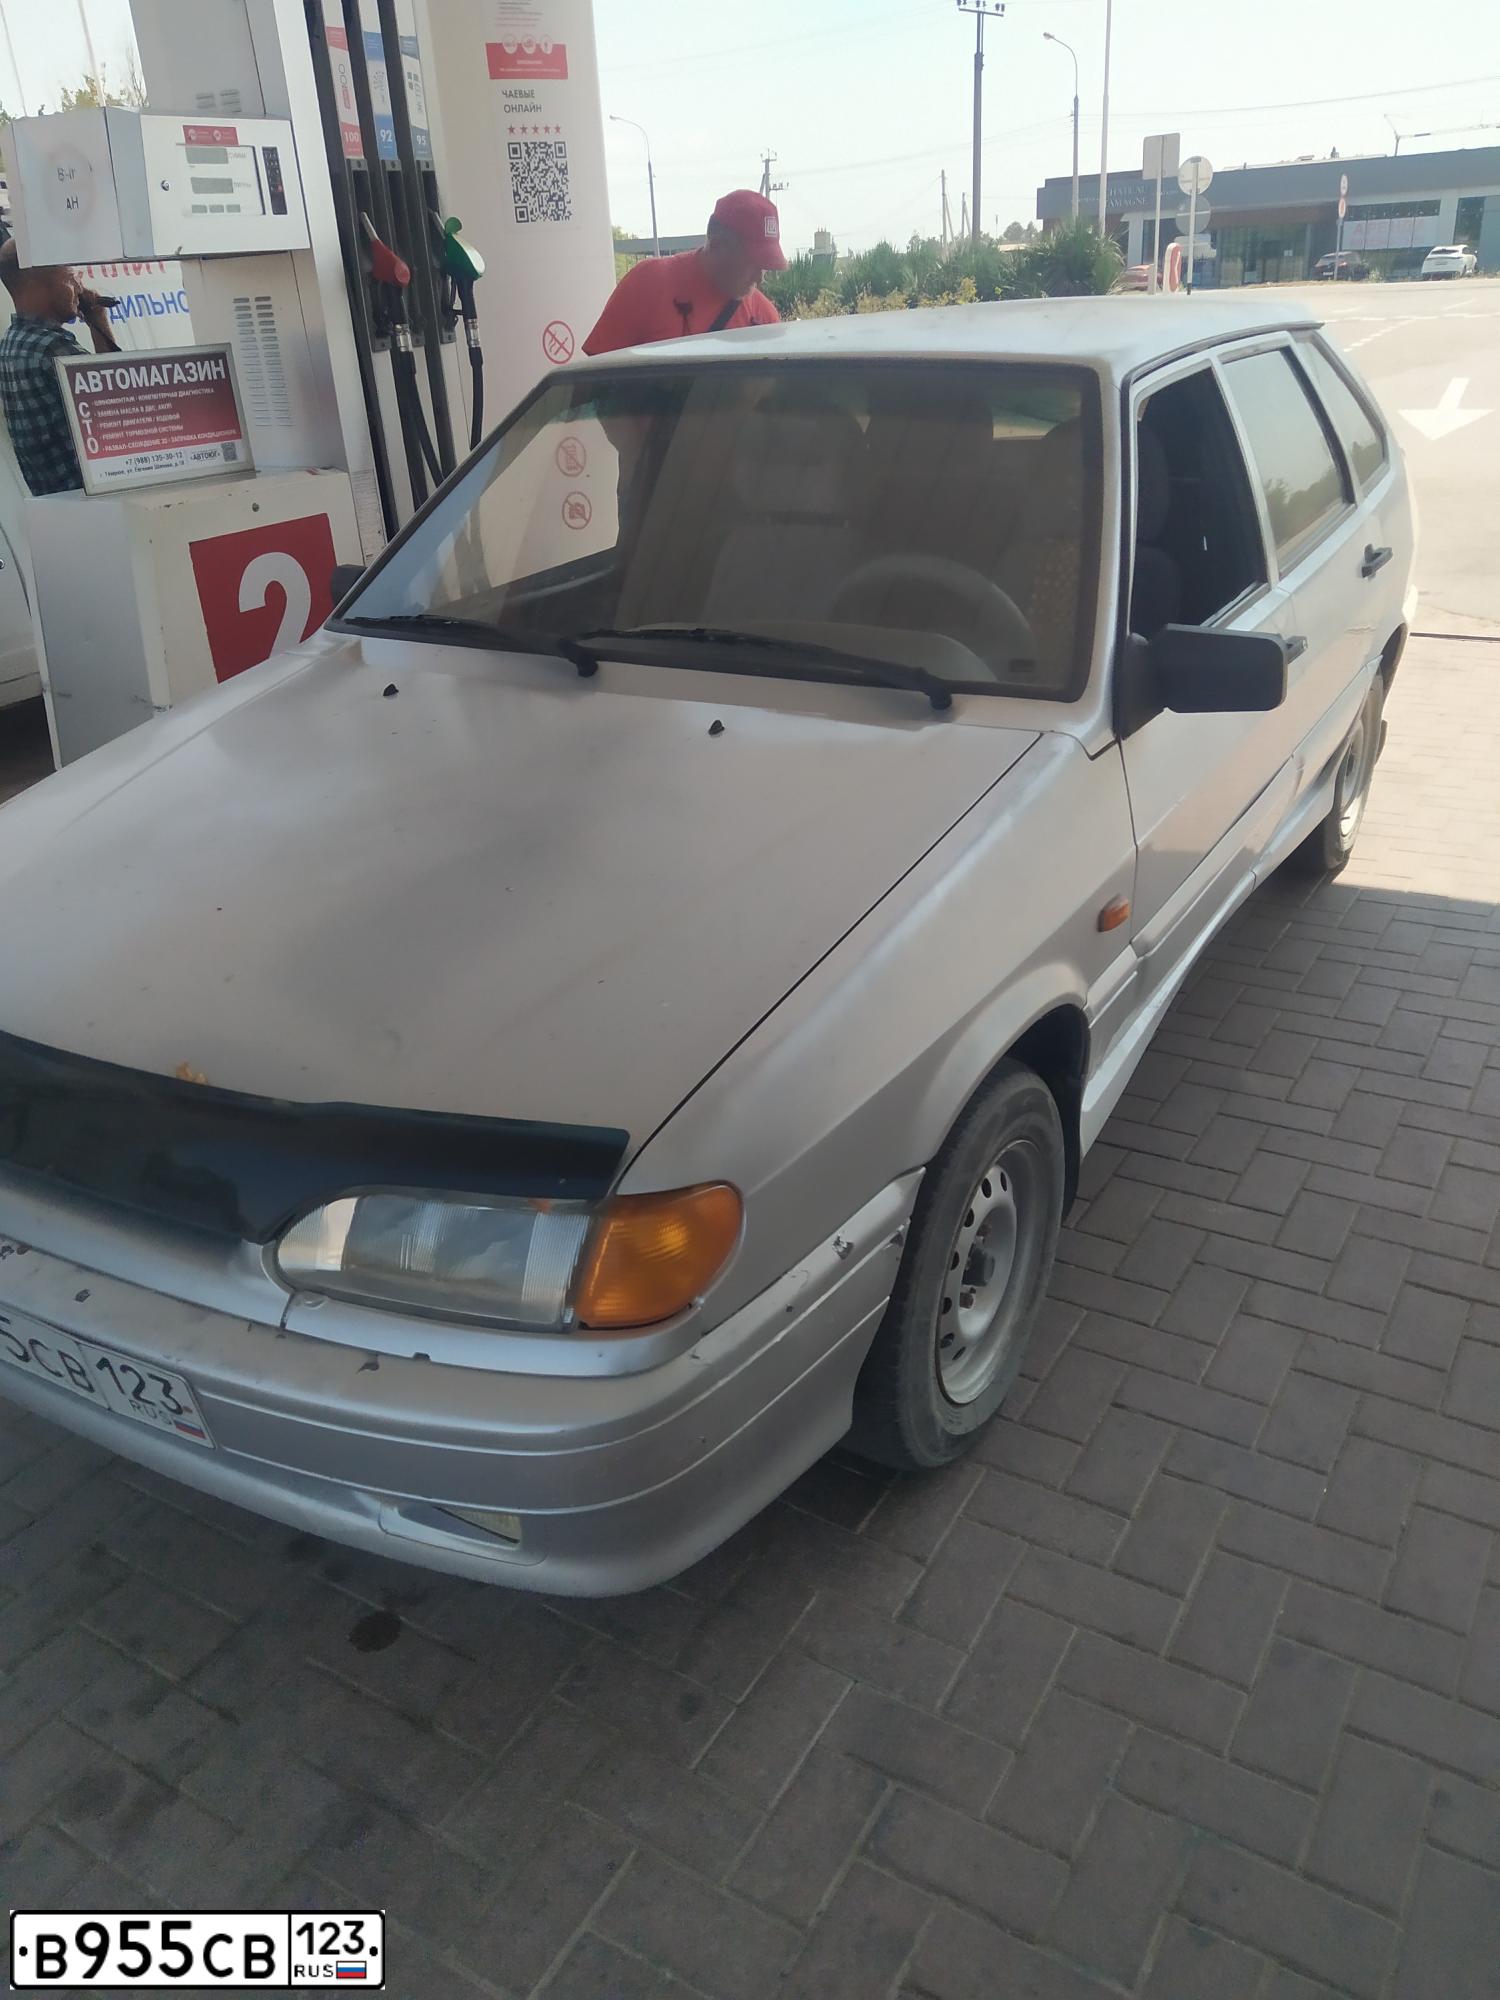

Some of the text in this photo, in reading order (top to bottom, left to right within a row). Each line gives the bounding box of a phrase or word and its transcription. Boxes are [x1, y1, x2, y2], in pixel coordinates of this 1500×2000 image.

[501, 89, 535, 99] ЧАЕВЫЕ
[503, 102, 542, 113] ОНЛАЙН
[344, 131, 358, 142] 100
[380, 129, 392, 142] 92
[416, 135, 426, 146] 95
[108, 290, 190, 324] ДИЛЬНО
[74, 359, 226, 394] АВТОМАГАЗИН
[178, 388, 215, 398] ДИАГНОСТИКА
[78, 402, 99, 454] СТО
[99, 419, 121, 429] РЕМОНТ
[103, 431, 124, 441] РЕМОНТ
[239, 552, 311, 658] 2
[96, 1357, 184, 1415] 123
[129, 1399, 173, 1426] RUS
